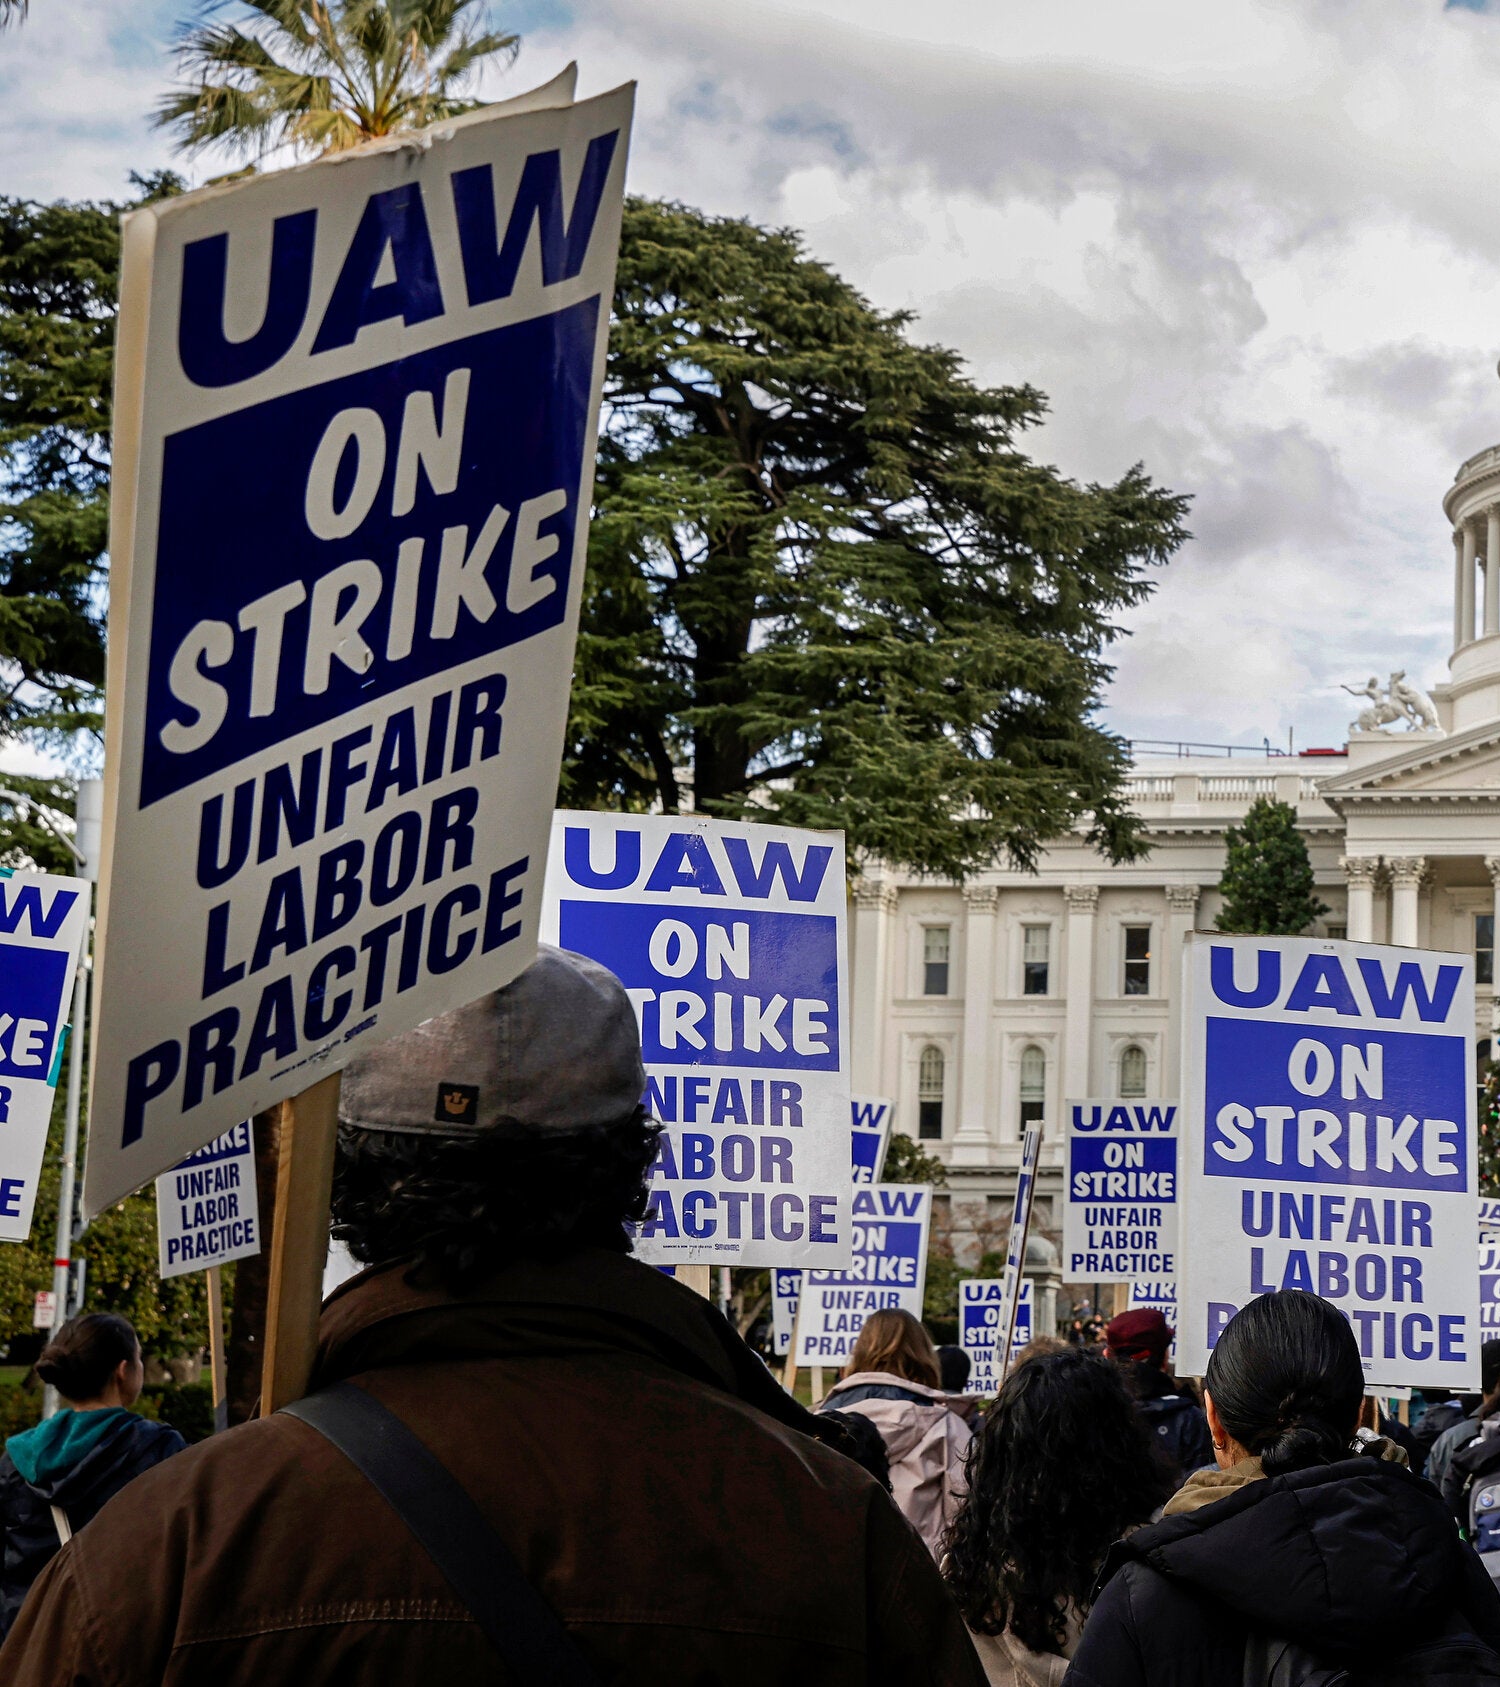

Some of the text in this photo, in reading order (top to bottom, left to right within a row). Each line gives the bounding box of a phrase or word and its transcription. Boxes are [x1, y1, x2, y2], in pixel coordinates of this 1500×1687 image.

[178, 129, 620, 388] UAW
[304, 368, 471, 540] ON
[160, 489, 567, 754] STRIKE
[197, 674, 507, 889] UNFAIR
[564, 827, 833, 902] UAW
[201, 786, 475, 1000] LABOR
[649, 919, 749, 980] ON
[121, 855, 529, 1148] PRACTICE
[1210, 946, 1463, 1023] UAW
[625, 988, 830, 1056] TRIKE
[1288, 1038, 1383, 1100] ON
[645, 1076, 803, 1128] NFAIR
[1072, 1106, 1177, 1132] UAW
[648, 1133, 793, 1183] ABOR
[1103, 1142, 1144, 1168] ON
[1212, 1102, 1459, 1176] STRIKE
[176, 1163, 240, 1200] UNFAIR
[852, 1191, 923, 1217] AW
[1073, 1171, 1173, 1198] STRIKE
[182, 1193, 239, 1230] LABOR
[630, 1190, 838, 1244] ACTICE
[1085, 1208, 1162, 1227] UNFAIR
[1241, 1190, 1432, 1248] UNFAIR
[168, 1218, 255, 1264] PRACTICE
[852, 1226, 887, 1252] ON
[1071, 1253, 1173, 1273] PRACTICE
[1088, 1231, 1157, 1250] LABOR
[822, 1291, 900, 1310] UNFAIR
[1135, 1283, 1176, 1299] STR
[1250, 1247, 1423, 1303] LABOR
[824, 1314, 862, 1332] LAB
[965, 1326, 1030, 1344] STRKE
[1207, 1302, 1466, 1362] PTICE
